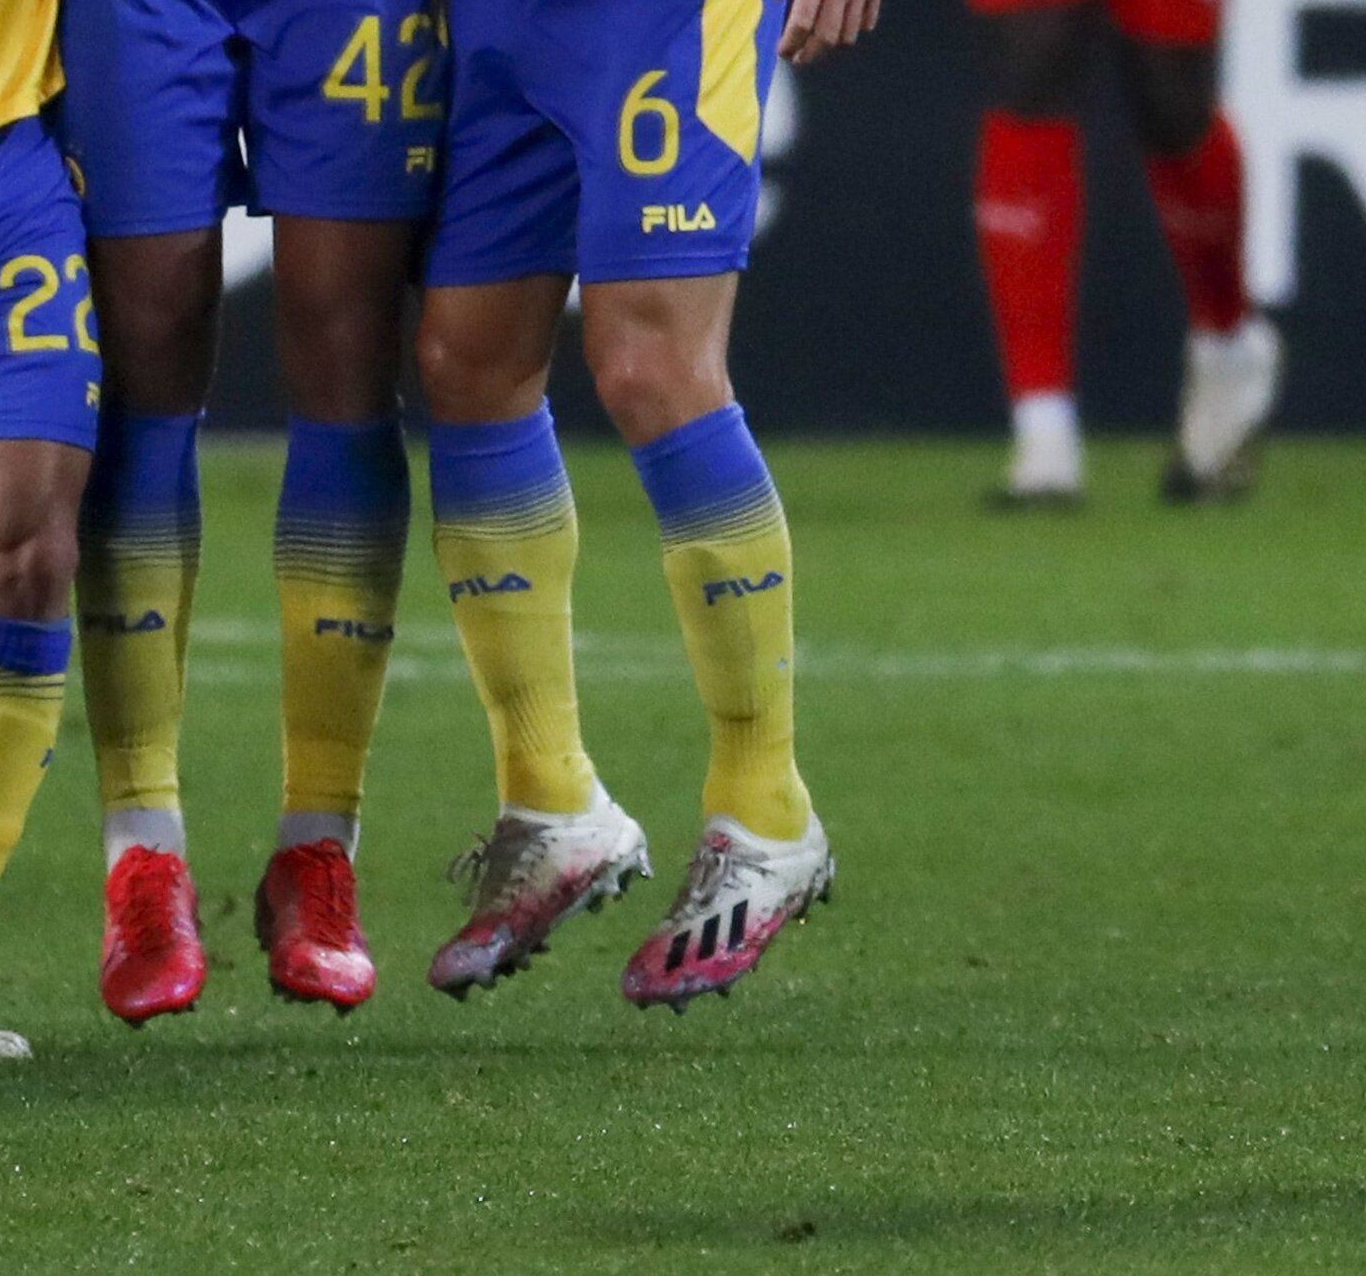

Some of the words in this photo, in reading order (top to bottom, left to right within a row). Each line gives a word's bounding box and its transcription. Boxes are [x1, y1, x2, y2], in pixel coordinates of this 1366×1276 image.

[322, 11, 450, 122] 42
[619, 69, 680, 176] 6
[641, 201, 717, 234] FILA
[449, 572, 532, 603] FILA
[703, 571, 784, 607] FILA
